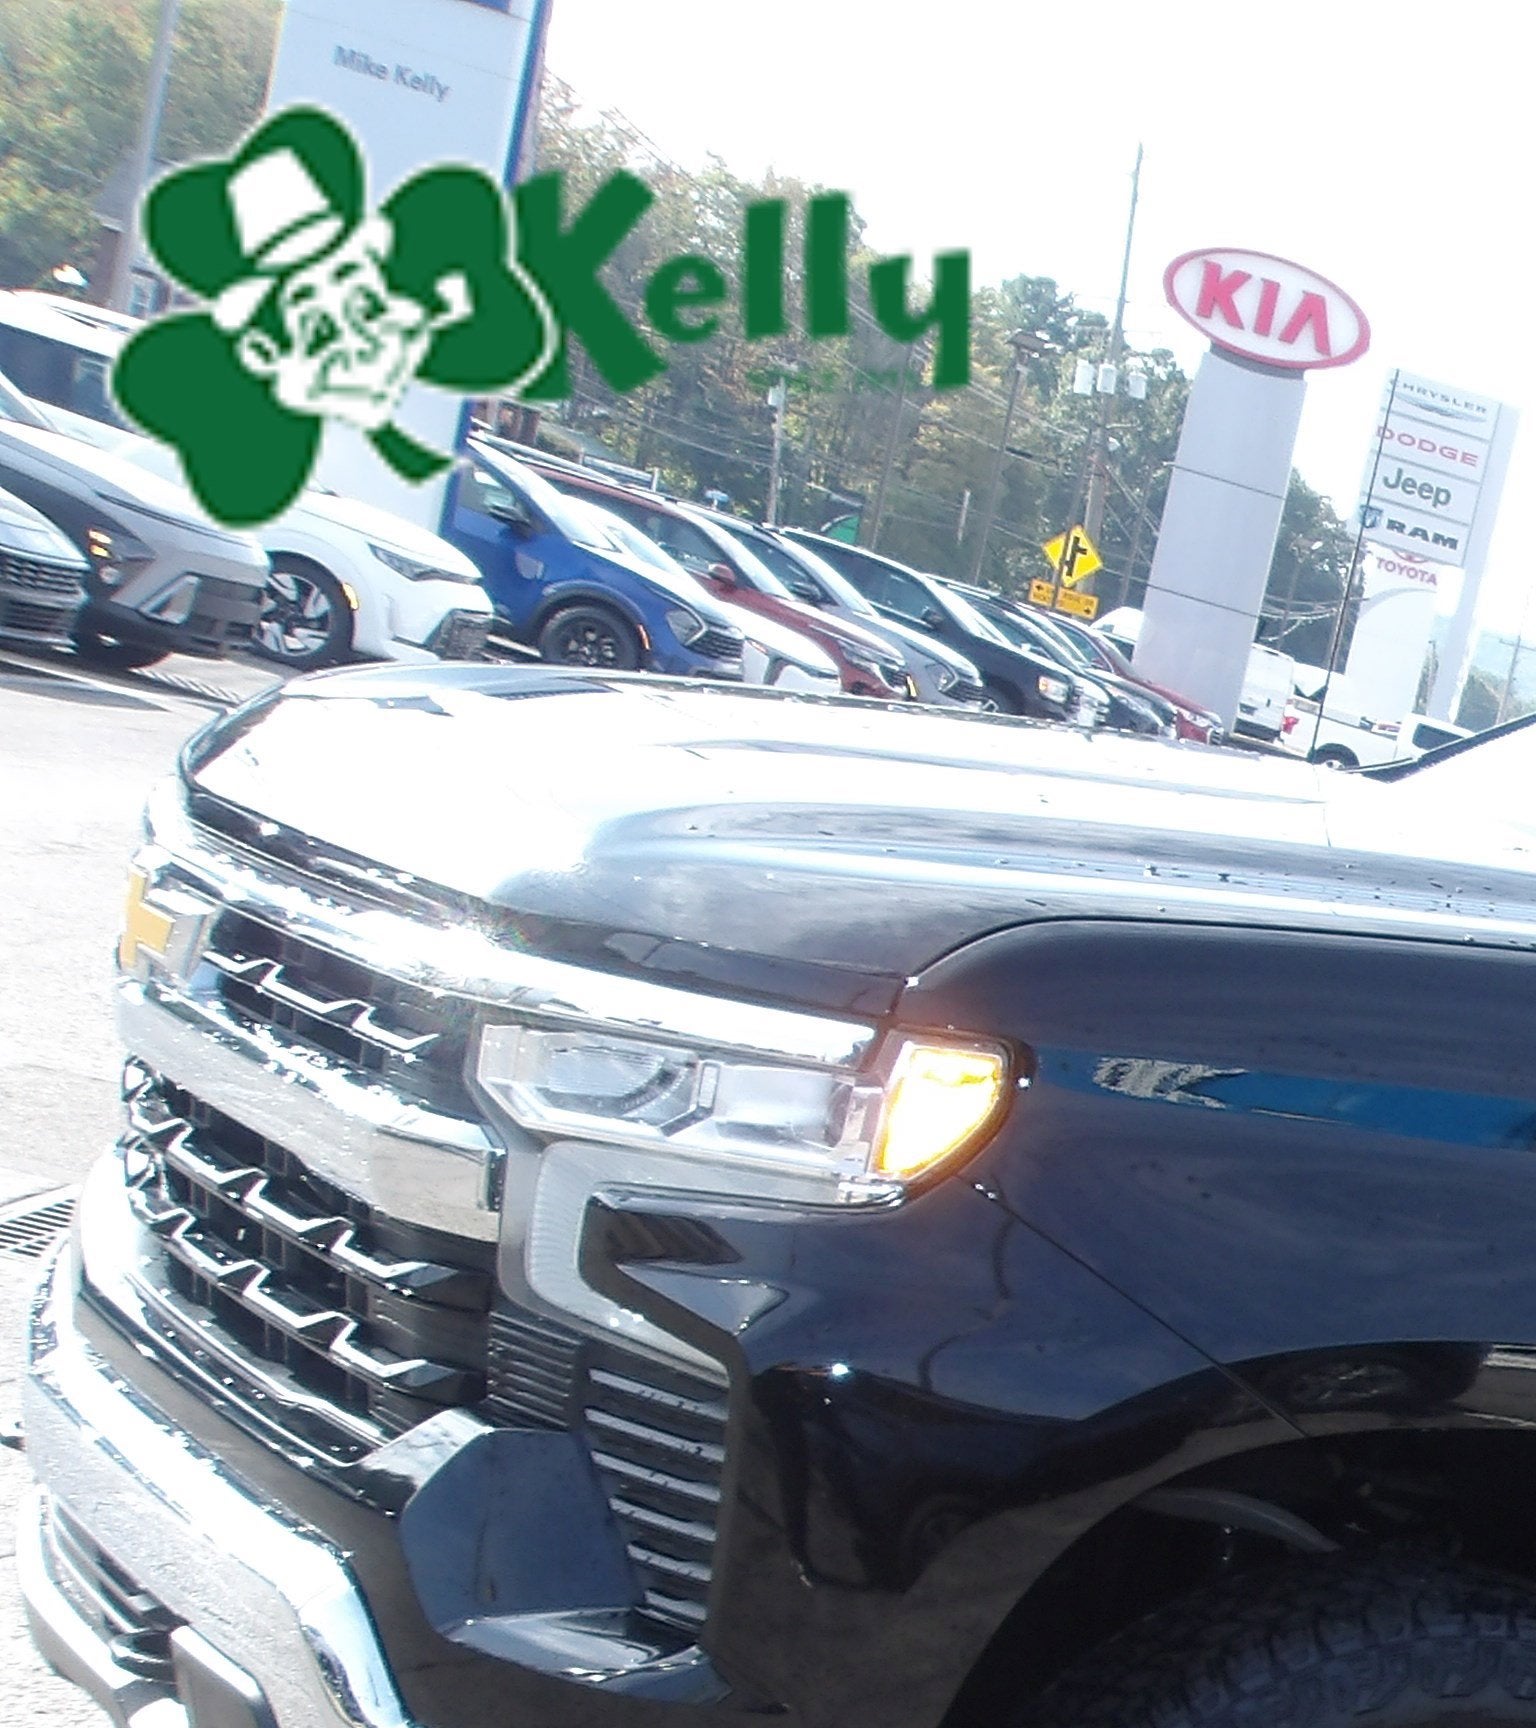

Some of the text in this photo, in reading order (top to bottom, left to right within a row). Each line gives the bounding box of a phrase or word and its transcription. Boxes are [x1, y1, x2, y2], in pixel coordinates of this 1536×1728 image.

[394, 63, 451, 103] Kelly
[1195, 259, 1331, 357] KIA
[1376, 425, 1479, 468] DODGE
[1382, 467, 1452, 508] Jeep
[1386, 517, 1460, 551] RAM
[1375, 556, 1438, 586] TOYOTA
